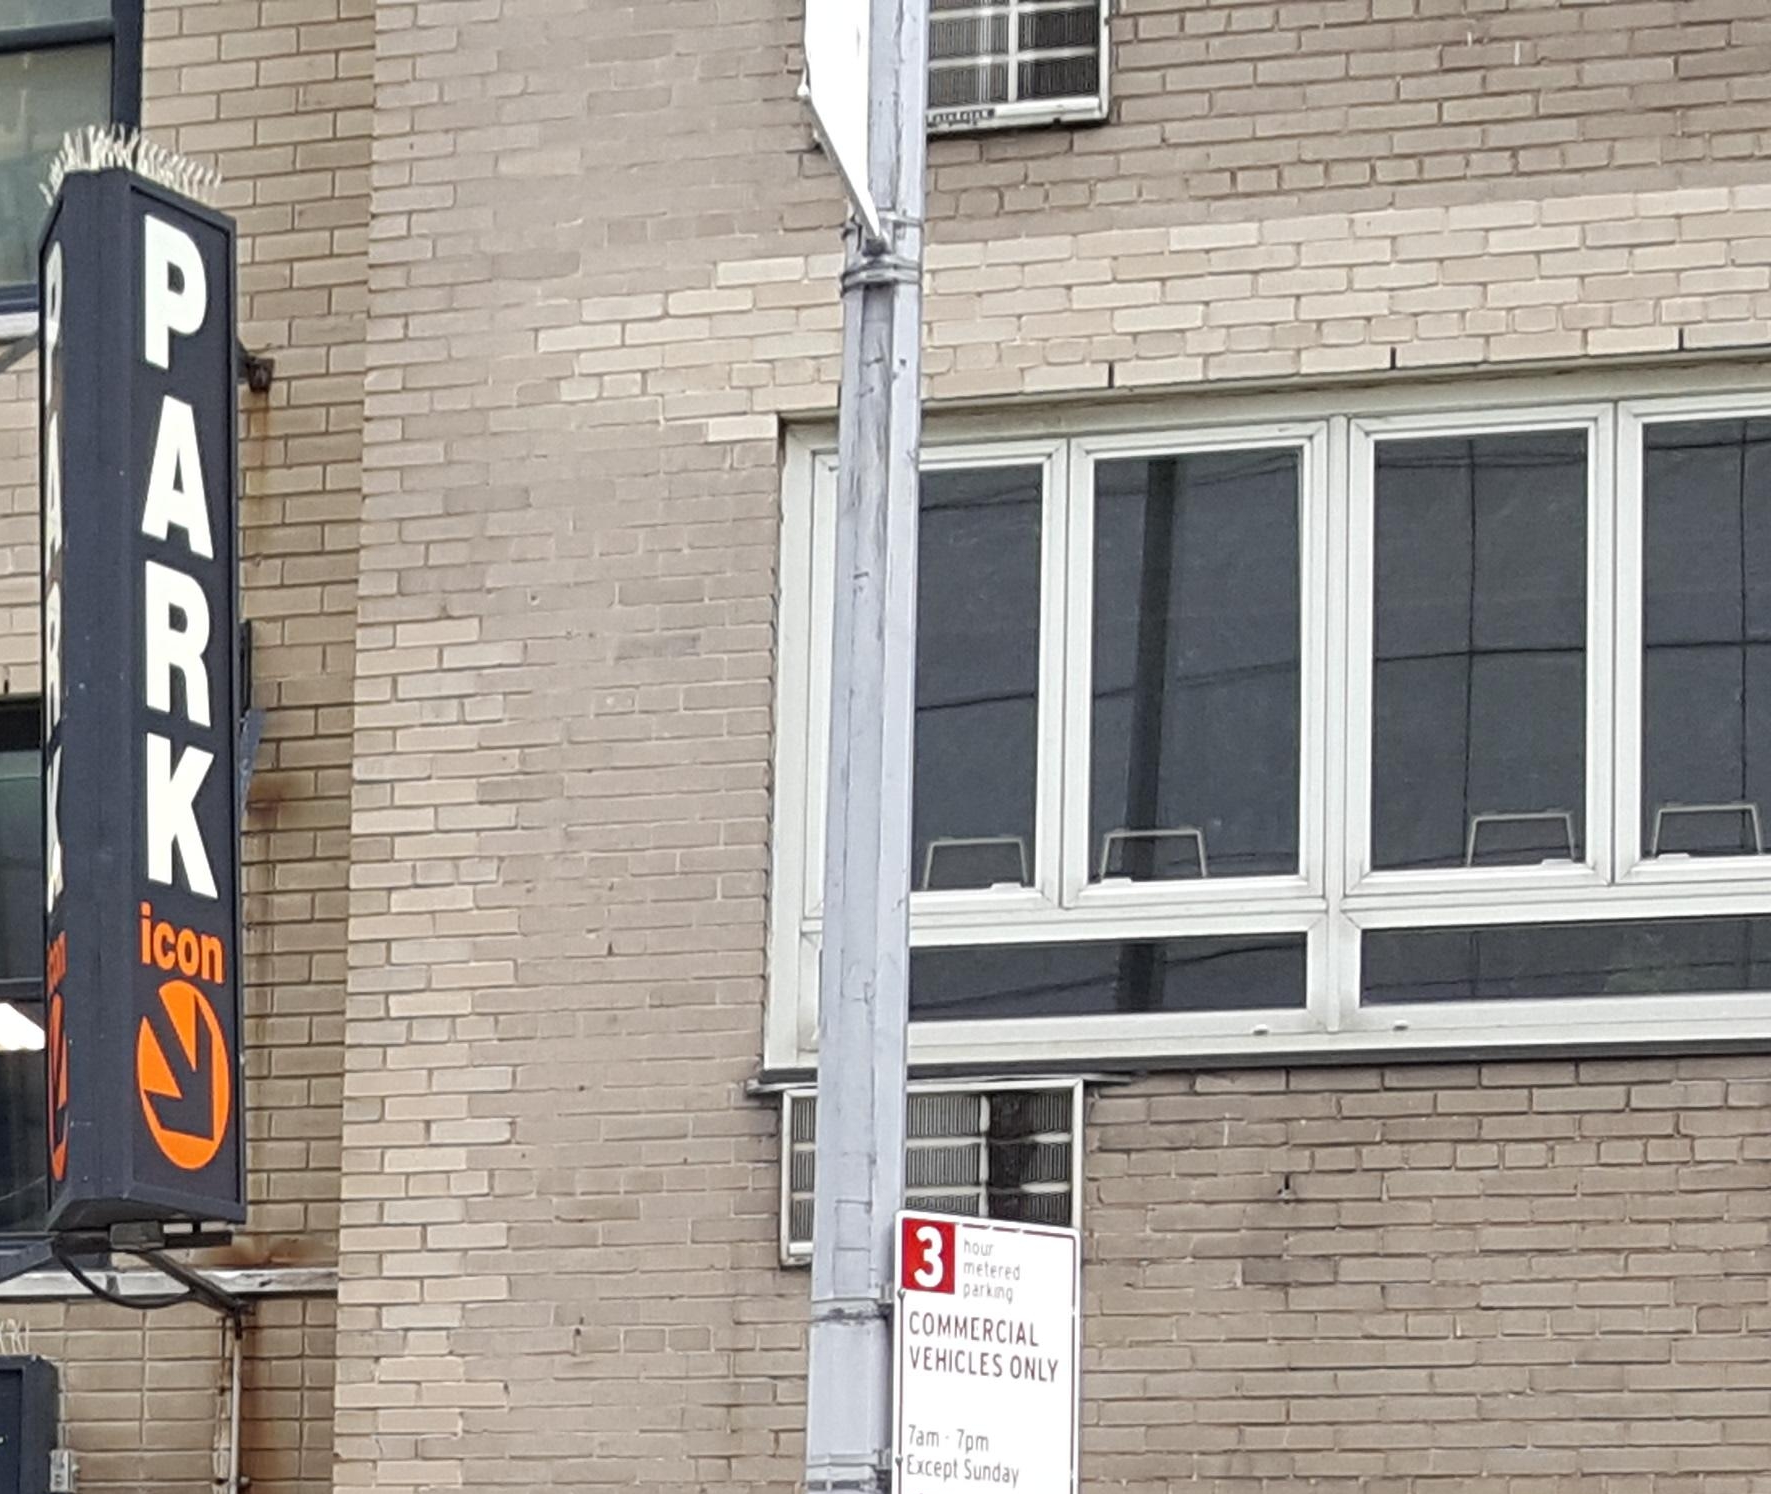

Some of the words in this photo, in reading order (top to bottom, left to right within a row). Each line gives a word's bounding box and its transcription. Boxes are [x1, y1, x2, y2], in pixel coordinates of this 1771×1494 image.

[141, 212, 219, 902] PARK
[140, 901, 224, 984] icon
[914, 1225, 944, 1288] 3
[963, 1238, 993, 1258] hour
[963, 1260, 1021, 1282] metered
[963, 1281, 1014, 1304] parking
[908, 1310, 1040, 1347] COMMERCIAL
[909, 1345, 1003, 1378] VEHICLES
[1010, 1354, 1059, 1383] ONLY
[907, 1424, 940, 1449] 7am
[956, 1429, 990, 1453] 7pm
[906, 1454, 959, 1481] Except
[964, 1458, 1020, 1488] Sunday
